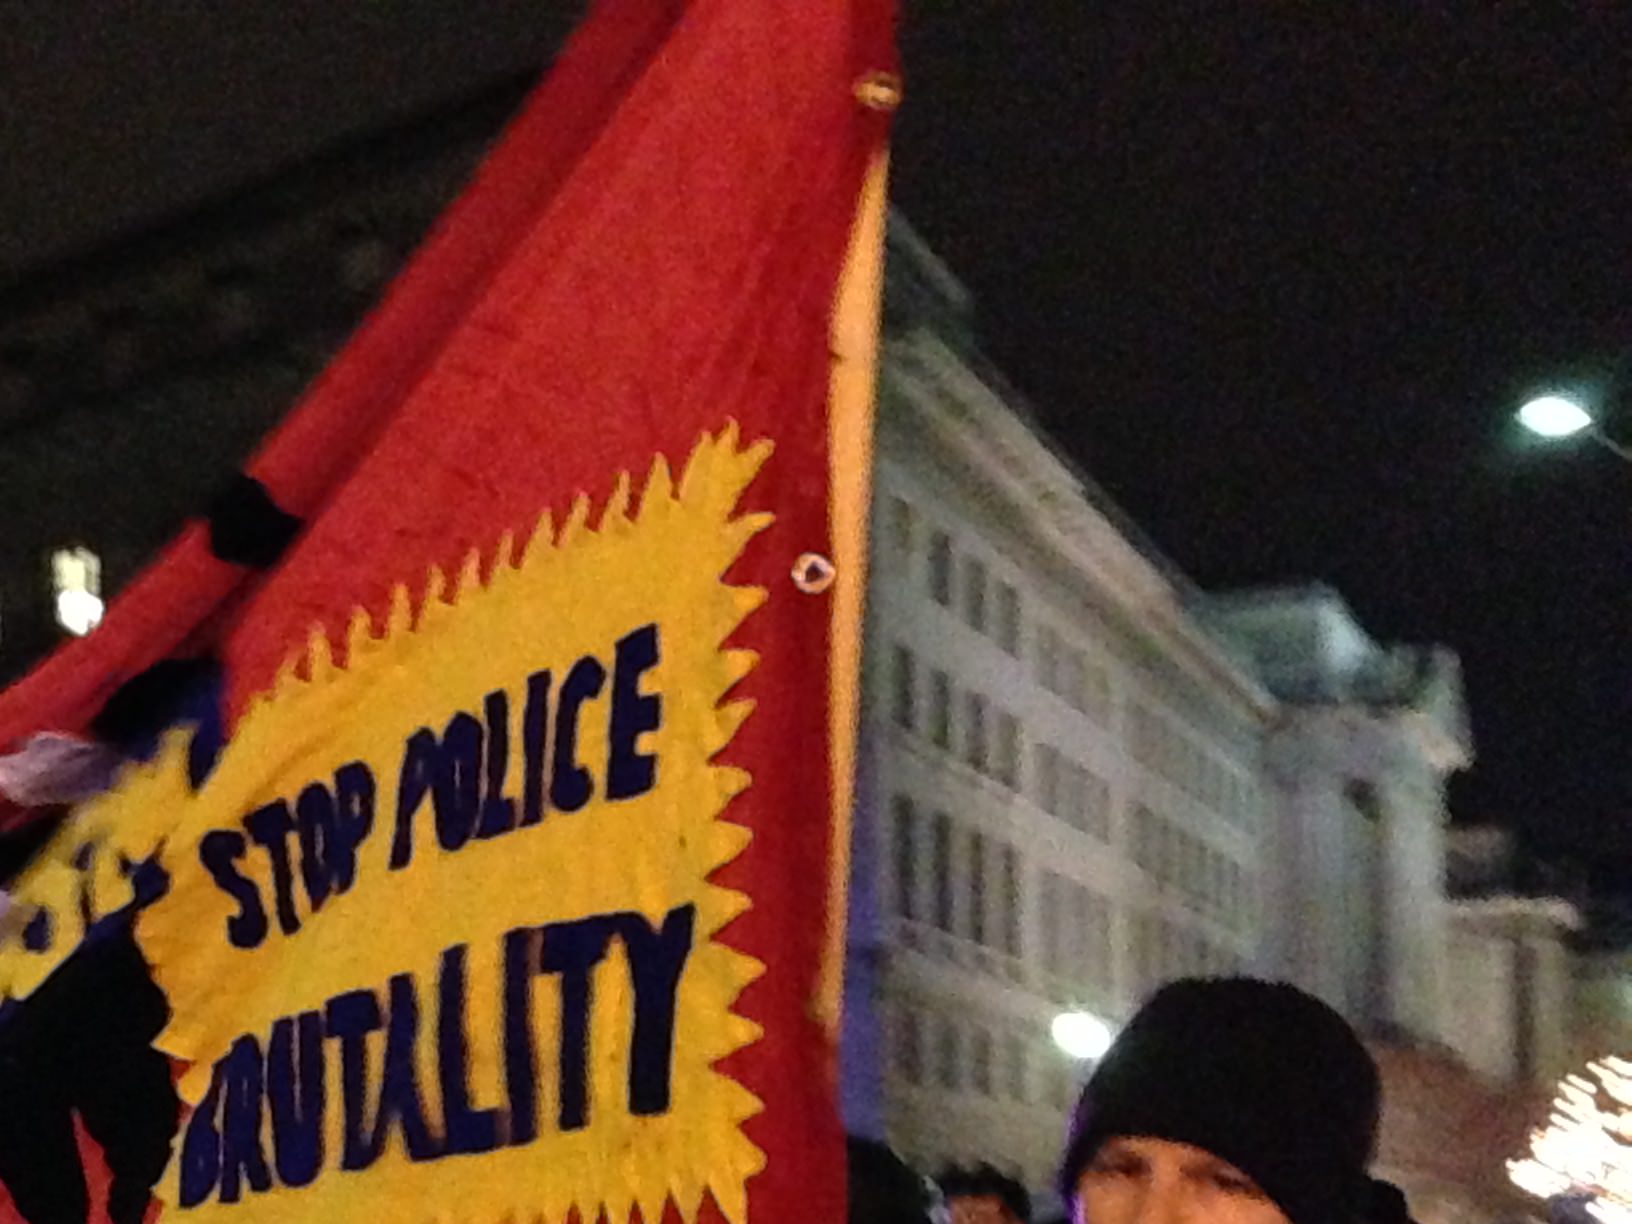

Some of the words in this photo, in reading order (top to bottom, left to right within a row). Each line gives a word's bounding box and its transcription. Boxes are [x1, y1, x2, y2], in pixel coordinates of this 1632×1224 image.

[199, 760, 376, 949] STOP
[388, 623, 663, 871] POLICE
[178, 902, 696, 1210] BRUTALITY
